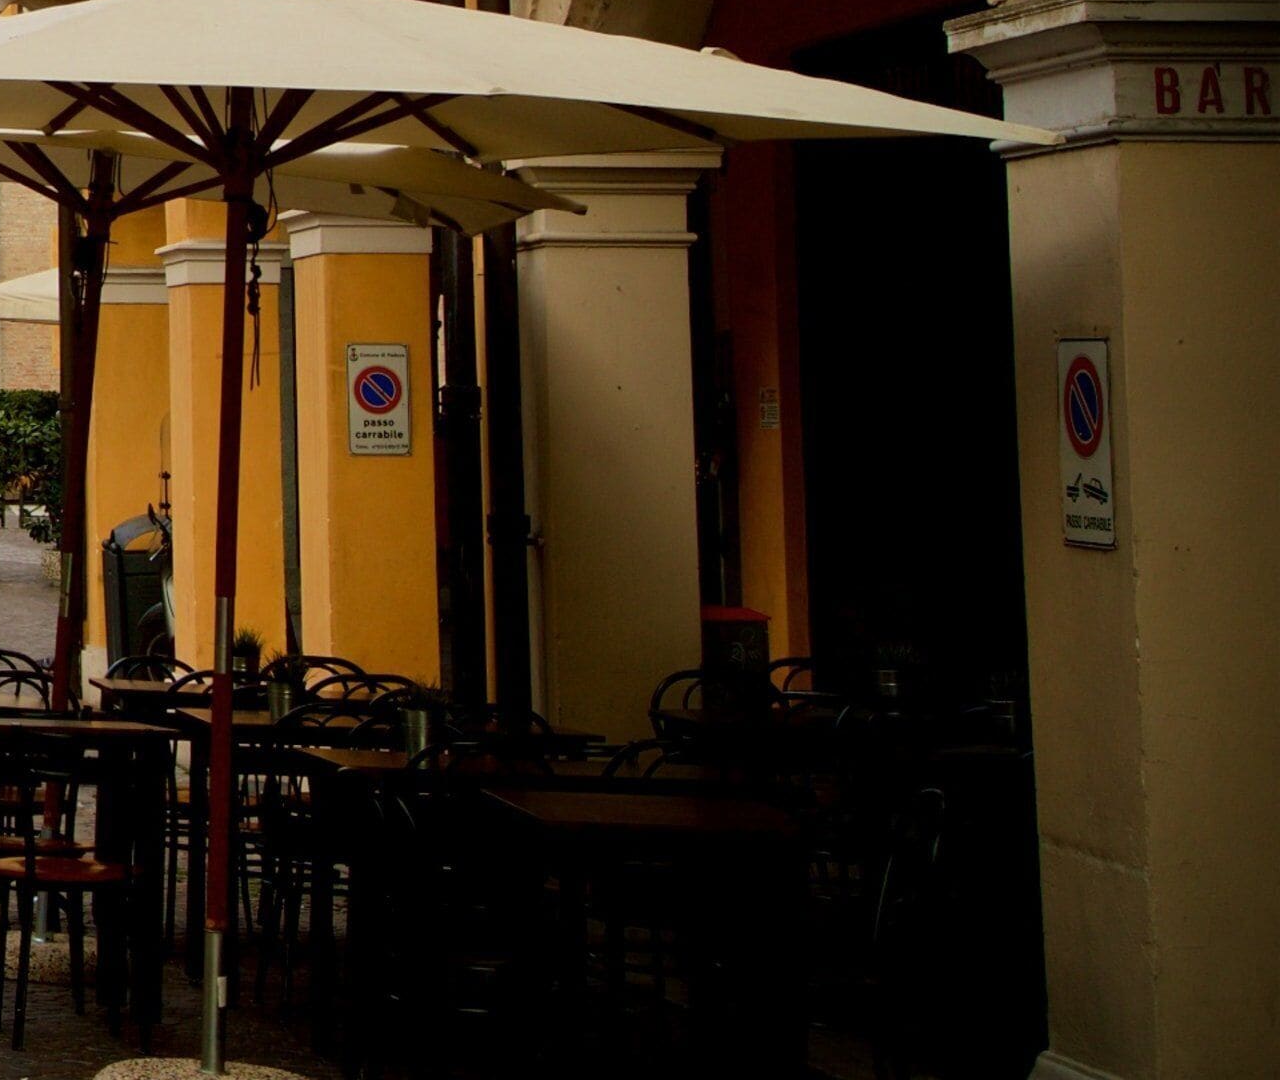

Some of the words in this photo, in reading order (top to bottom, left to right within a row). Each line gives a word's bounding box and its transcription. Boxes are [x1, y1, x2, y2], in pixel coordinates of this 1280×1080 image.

[1153, 66, 1272, 115] BAR
[363, 419, 395, 428] passo
[355, 430, 404, 439] carrabile
[1065, 514, 1082, 529] PASSO
[1083, 516, 1112, 531] CARRABILE
